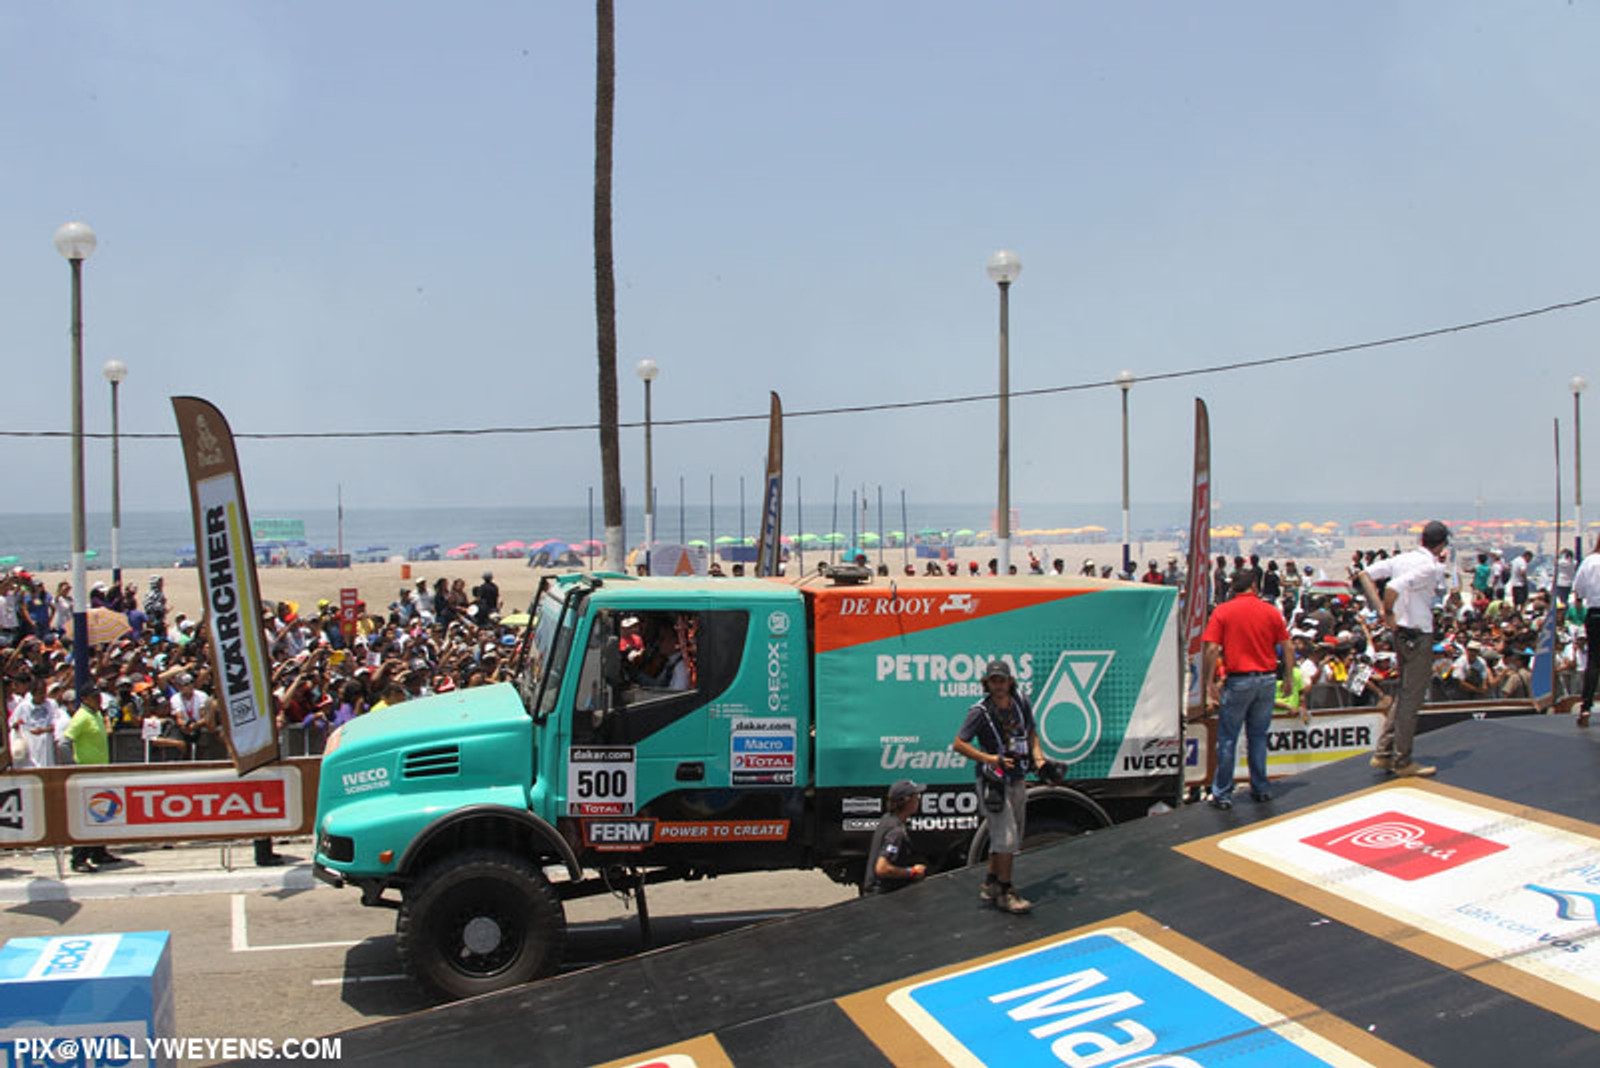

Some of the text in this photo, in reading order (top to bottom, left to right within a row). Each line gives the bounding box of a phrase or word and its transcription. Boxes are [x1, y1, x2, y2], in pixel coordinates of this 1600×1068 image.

[839, 597, 936, 616] DE ROOY
[767, 642, 780, 712] GEOX
[744, 738, 784, 750] Macro
[749, 756, 792, 766] TOTAL
[880, 744, 968, 770] Urania
[1123, 753, 1180, 772] IVECO
[342, 767, 388, 786] IVECO
[577, 769, 628, 798] 500
[132, 787, 281, 819] TOTAL
[584, 804, 621, 814] TOTAL
[918, 791, 979, 814] ECO
[590, 823, 650, 842] FERM
[660, 824, 784, 837] POWER TO CREATE
[907, 815, 979, 831] HOUTEN
